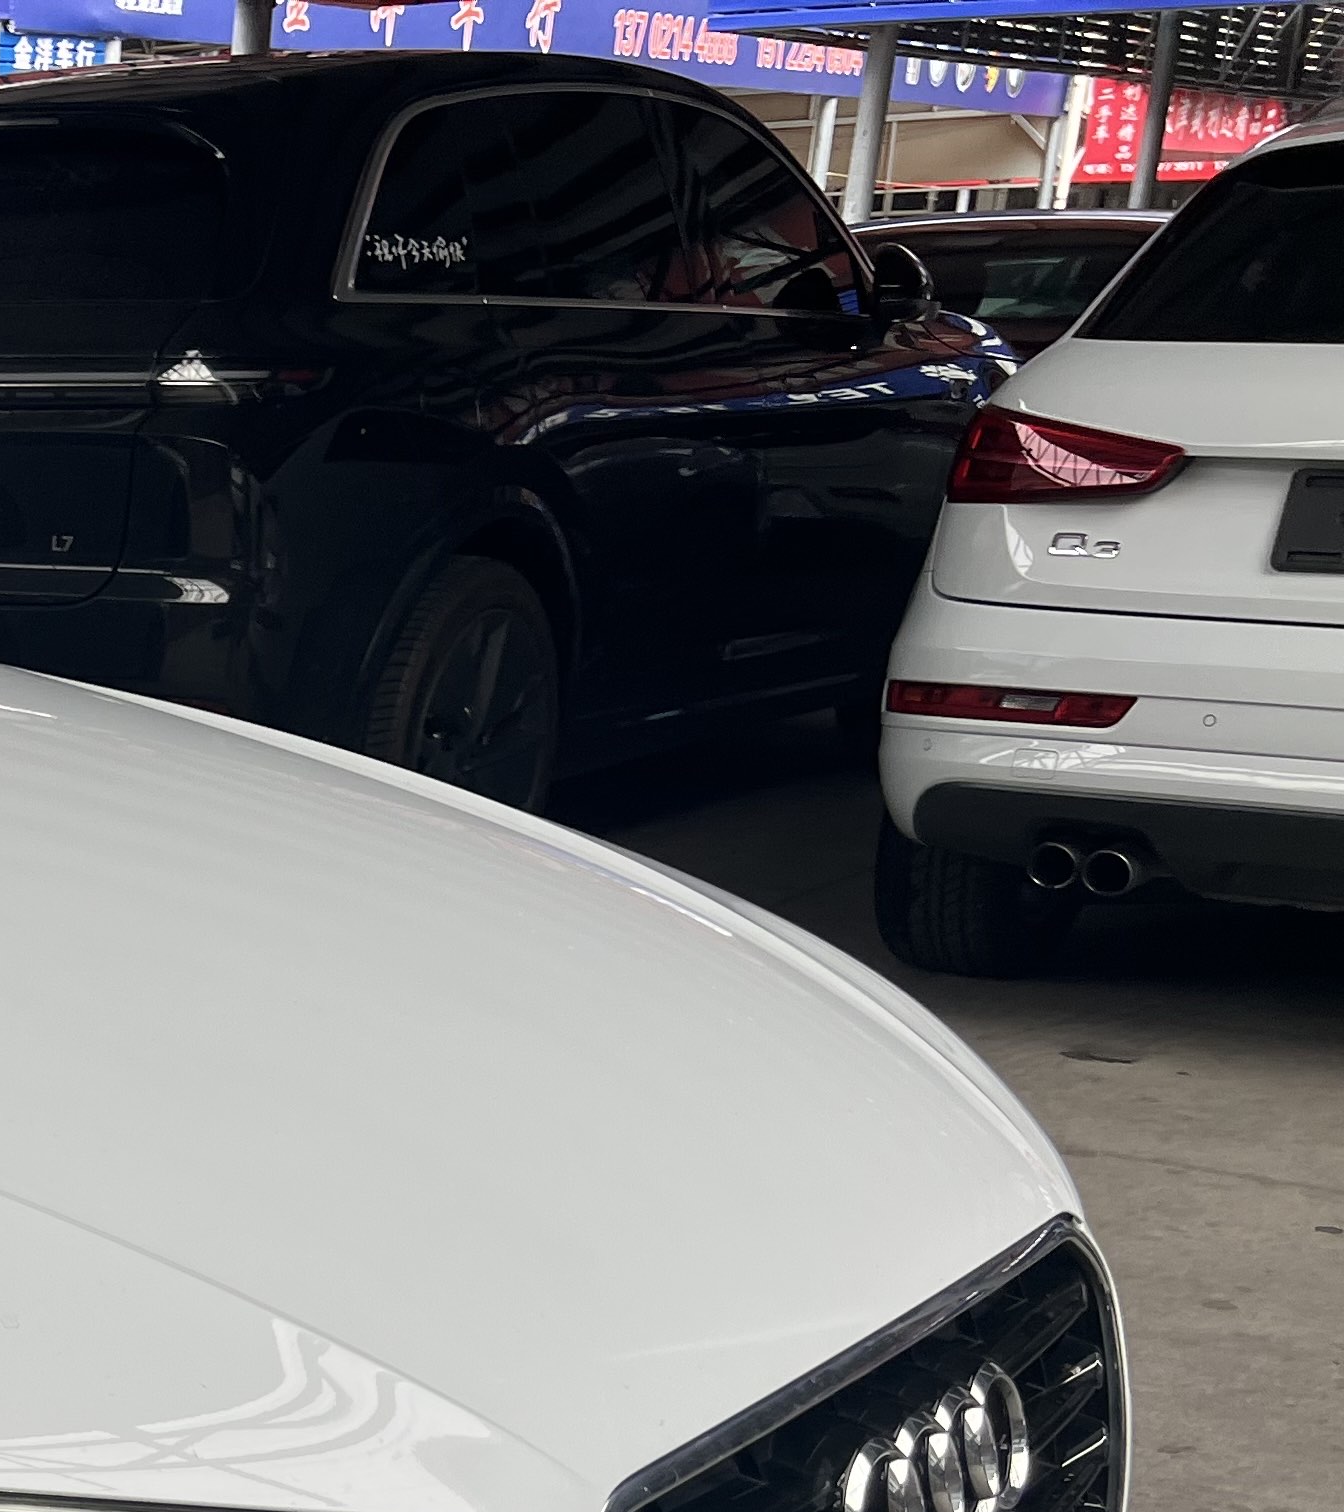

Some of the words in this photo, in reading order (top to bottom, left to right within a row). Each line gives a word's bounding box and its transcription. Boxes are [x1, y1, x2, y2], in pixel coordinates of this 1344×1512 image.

[614, 9, 649, 57] 137
[648, 12, 694, 61] 0214
[52, 535, 74, 552] L7
[1047, 532, 1121, 559] Q3
